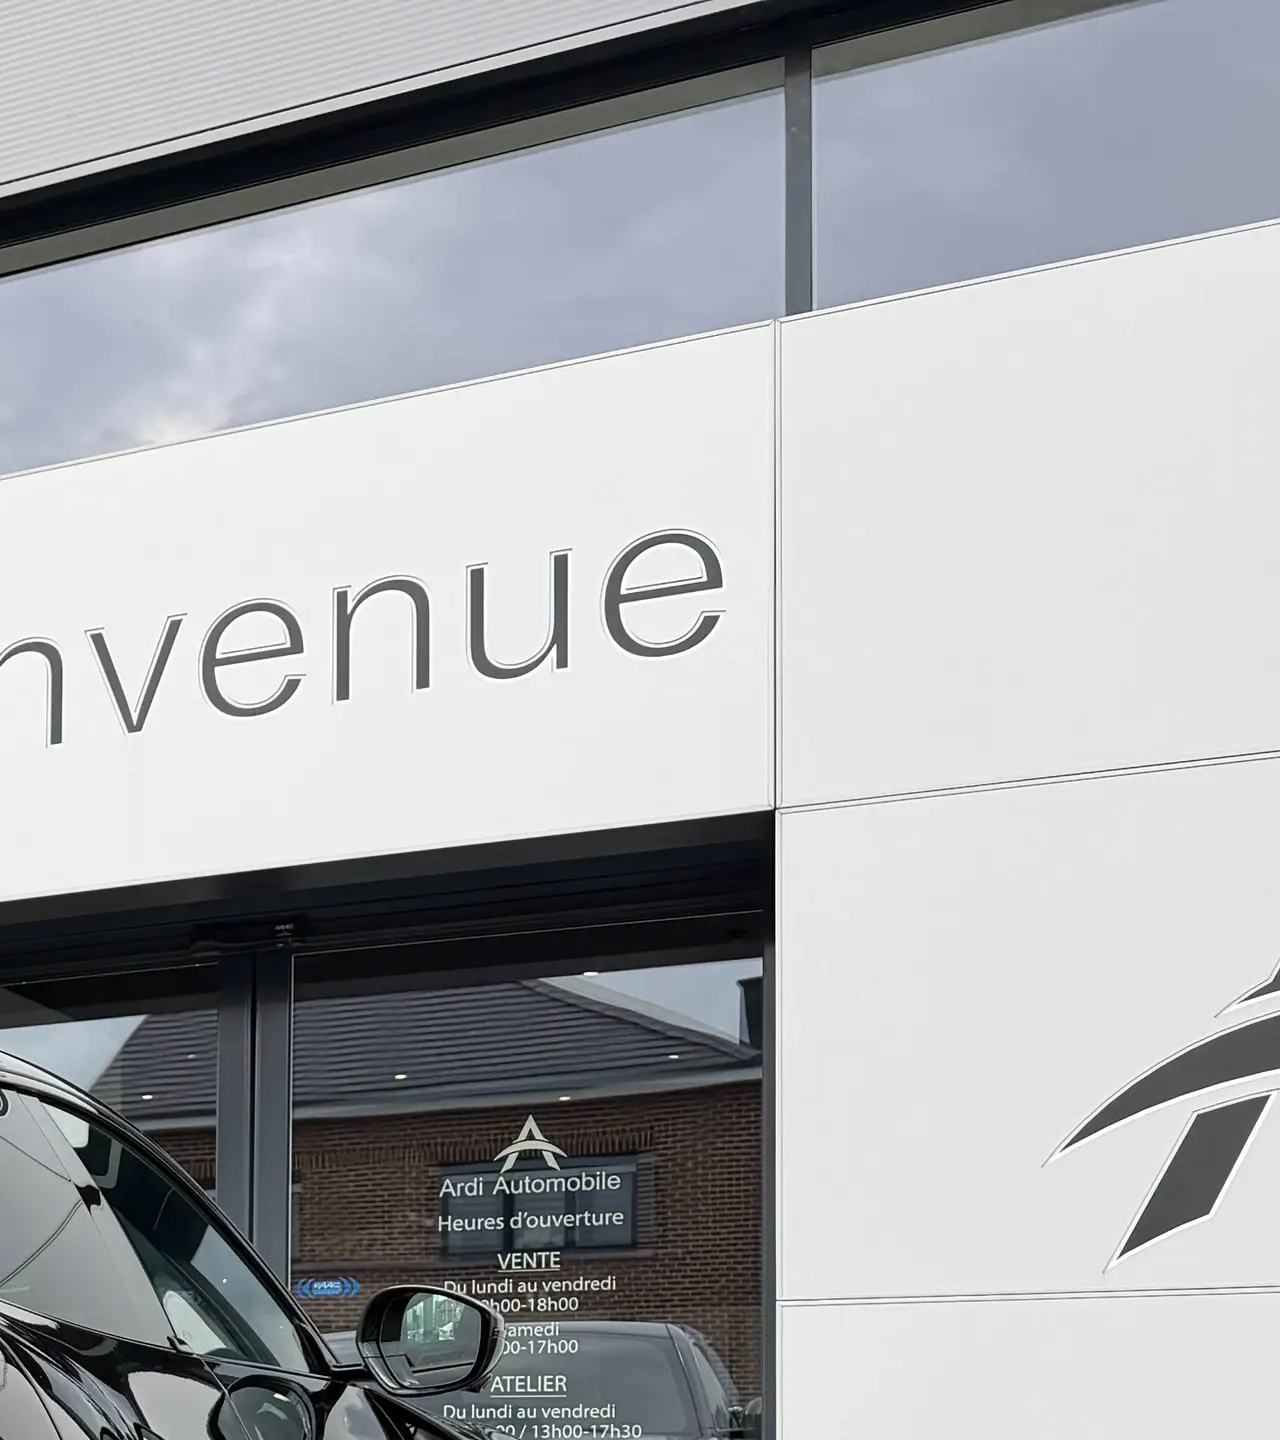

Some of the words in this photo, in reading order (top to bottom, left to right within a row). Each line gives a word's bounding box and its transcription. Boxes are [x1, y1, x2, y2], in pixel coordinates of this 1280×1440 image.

[439, 1177, 483, 1198] Ardi
[492, 1172, 621, 1196] Automobile
[438, 1214, 505, 1232] Heures
[510, 1210, 624, 1229] d'ouverture
[497, 1251, 561, 1270] VENTE
[444, 1280, 467, 1294] Du
[471, 1278, 513, 1294] lundi
[517, 1281, 537, 1293] au
[542, 1275, 616, 1292] vendredi
[505, 1321, 559, 1336] amedi
[490, 1375, 567, 1393] ATELIER
[443, 1404, 467, 1419] Du
[471, 1404, 512, 1419] lundi
[517, 1407, 537, 1419] au
[541, 1403, 616, 1419] vendredi
[532, 1423, 642, 1439] 13h00-17h30
